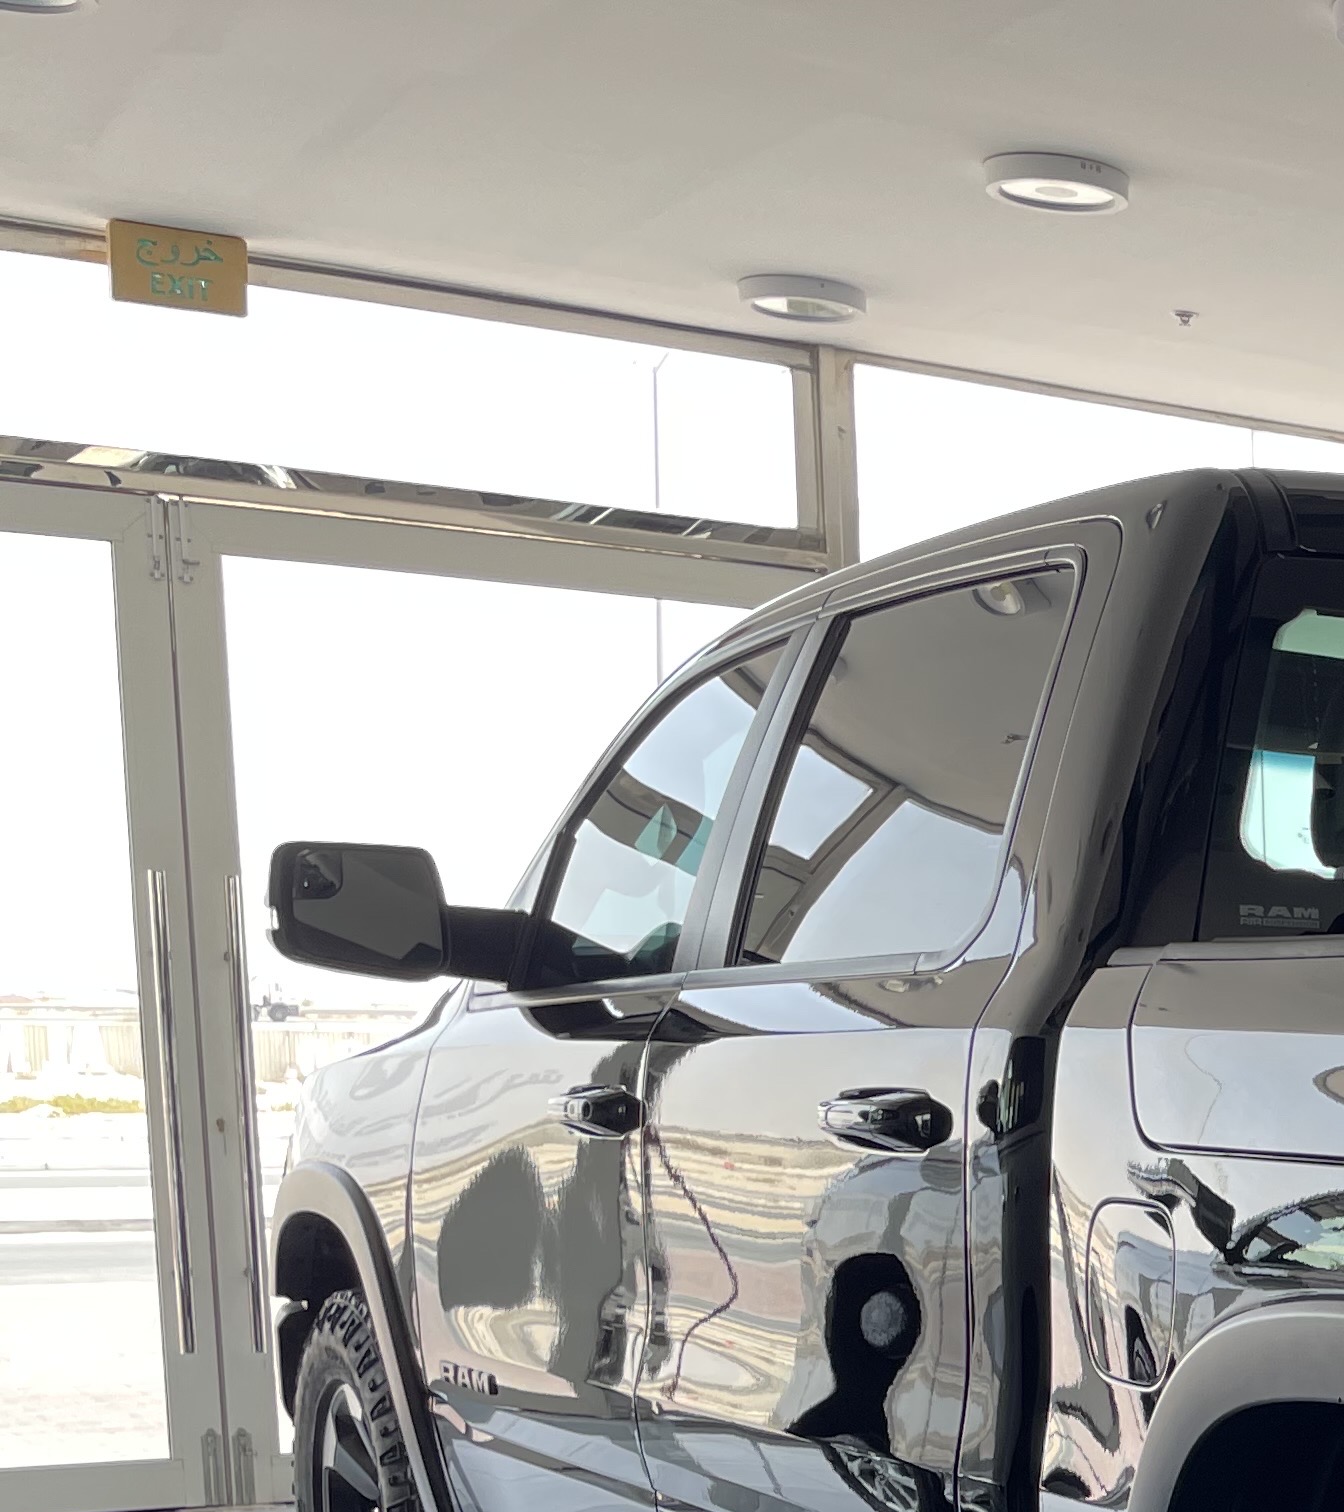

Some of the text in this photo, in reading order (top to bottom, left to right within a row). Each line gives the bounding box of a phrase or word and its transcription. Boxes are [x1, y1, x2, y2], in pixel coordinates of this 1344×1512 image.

[135, 238, 223, 267] خروج
[151, 271, 214, 301] EXIT
[1240, 904, 1319, 919] RAM
[440, 1360, 498, 1396] RAM
